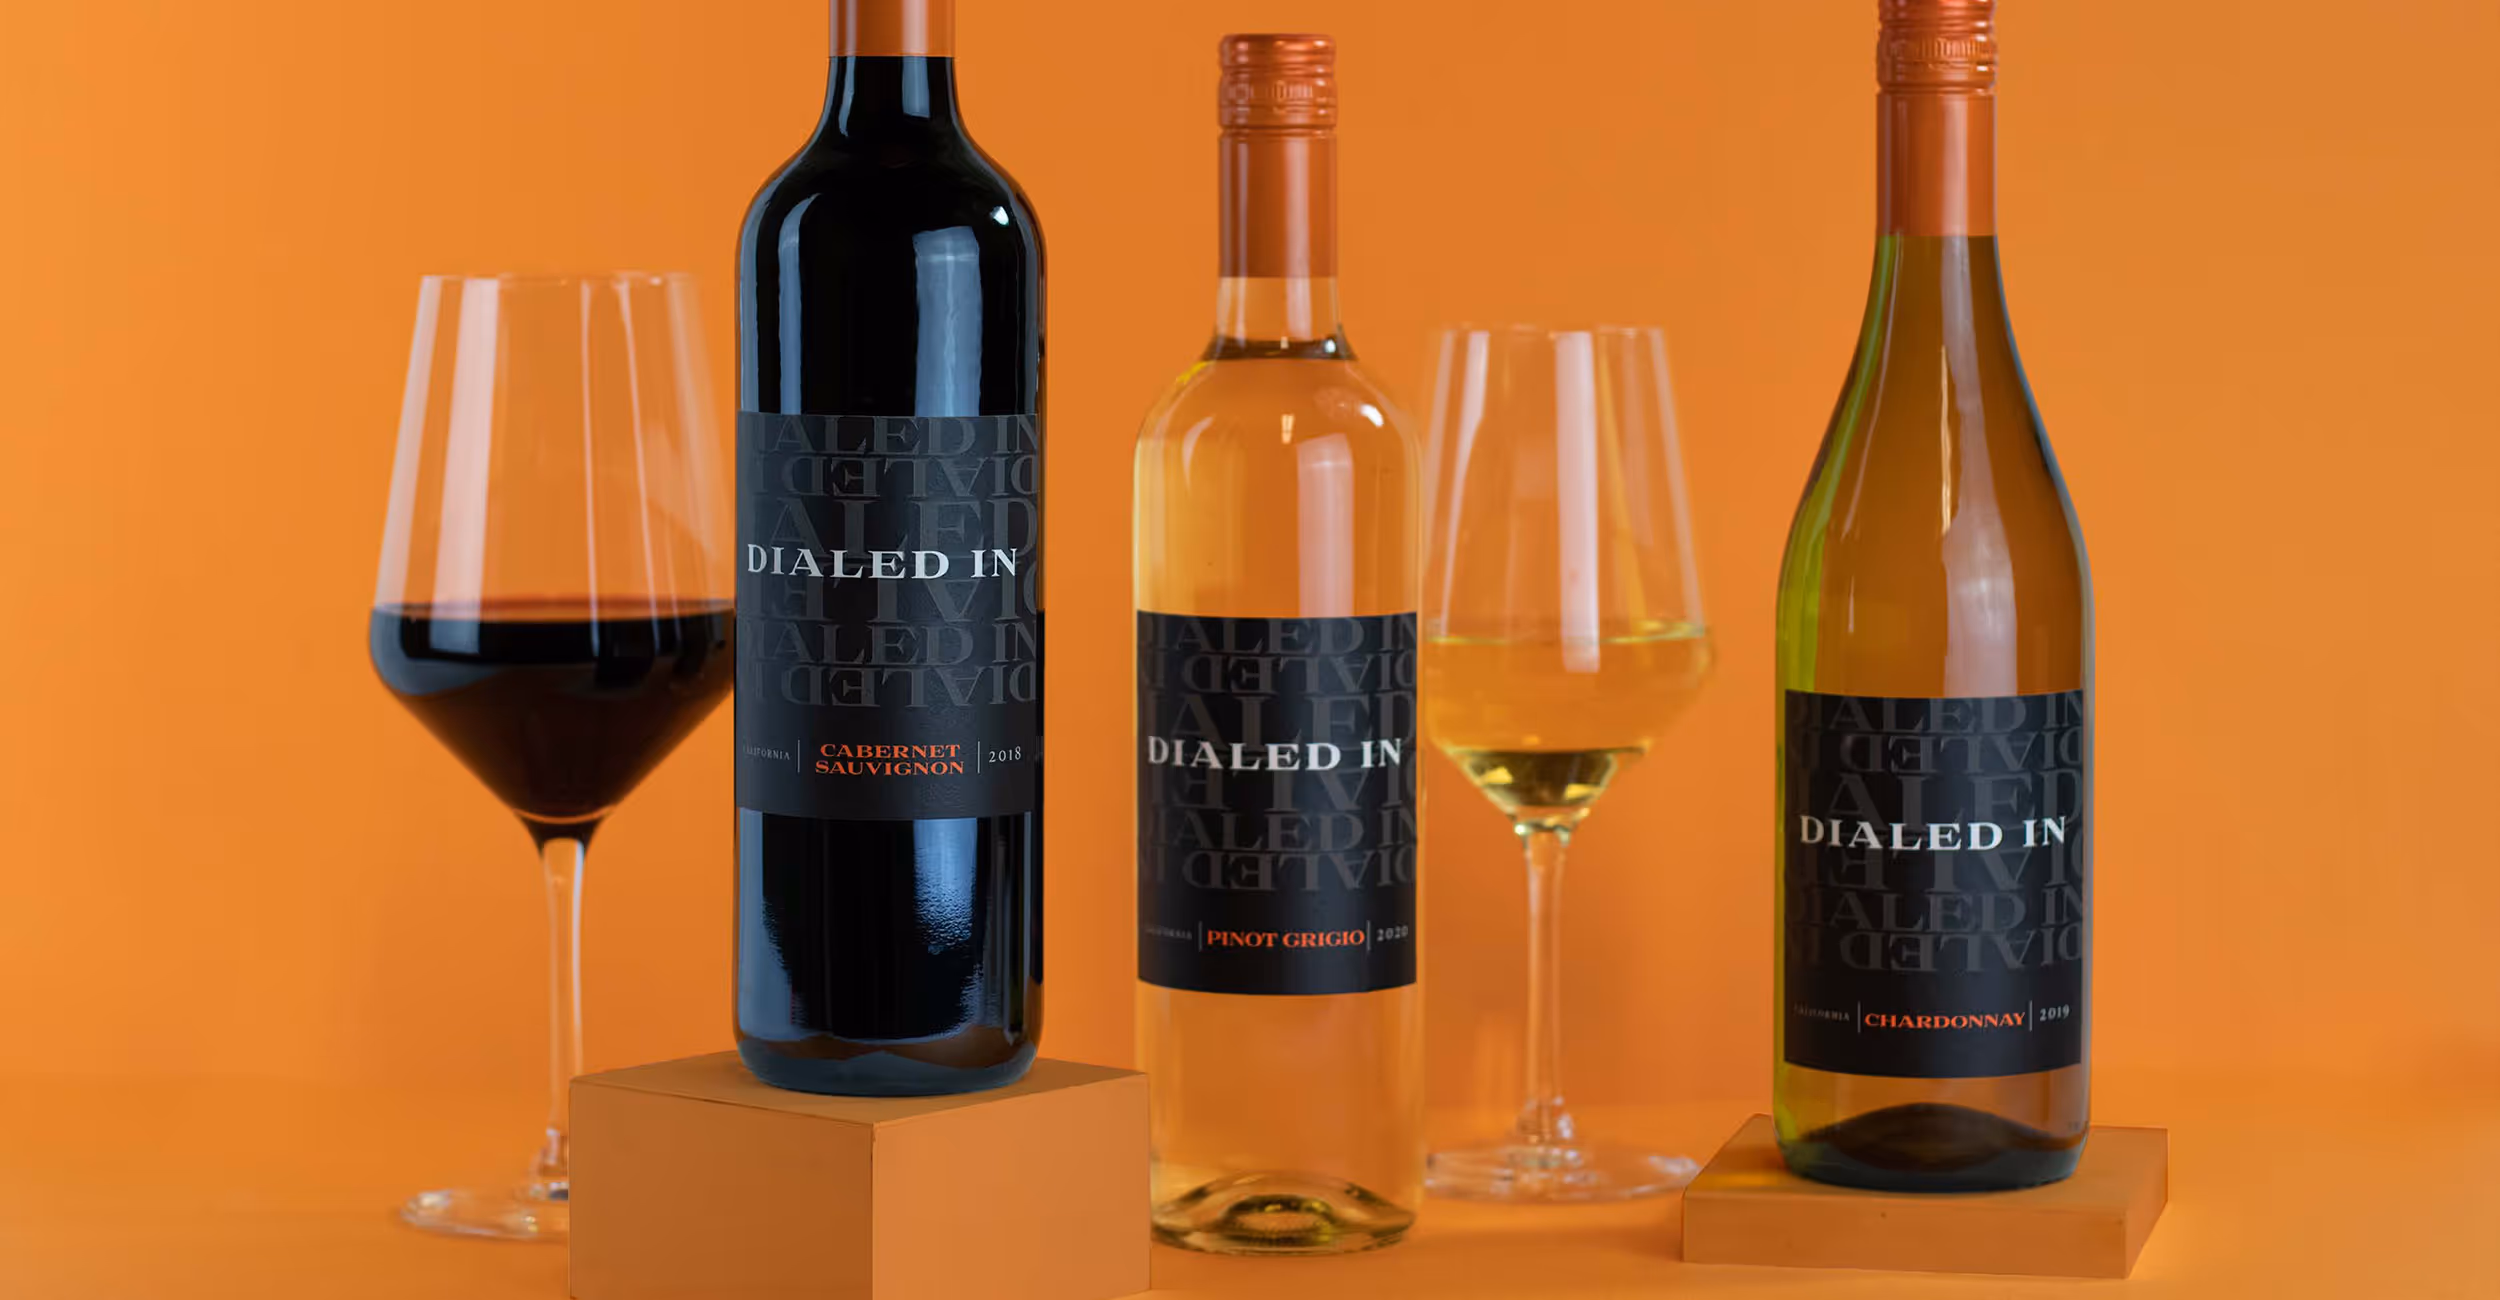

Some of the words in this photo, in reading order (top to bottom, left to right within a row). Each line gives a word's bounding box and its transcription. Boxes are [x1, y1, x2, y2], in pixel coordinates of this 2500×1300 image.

[747, 543, 950, 580] DIALED
[970, 547, 1018, 579] IN
[820, 743, 961, 759] CABERNET
[988, 746, 1022, 764] 2018
[1147, 736, 1342, 771] DIALED
[1360, 737, 1402, 769] IN
[815, 760, 965, 776] SAUVIGNON
[1800, 814, 2002, 851] DIALED
[2022, 815, 2066, 849] IN
[1206, 929, 1279, 948] PINOT
[1282, 929, 1366, 949] GRIGIO
[1376, 925, 1409, 942] 2020
[1864, 1011, 2026, 1030] CHARDONNAY
[2039, 1004, 2070, 1022] 2019
